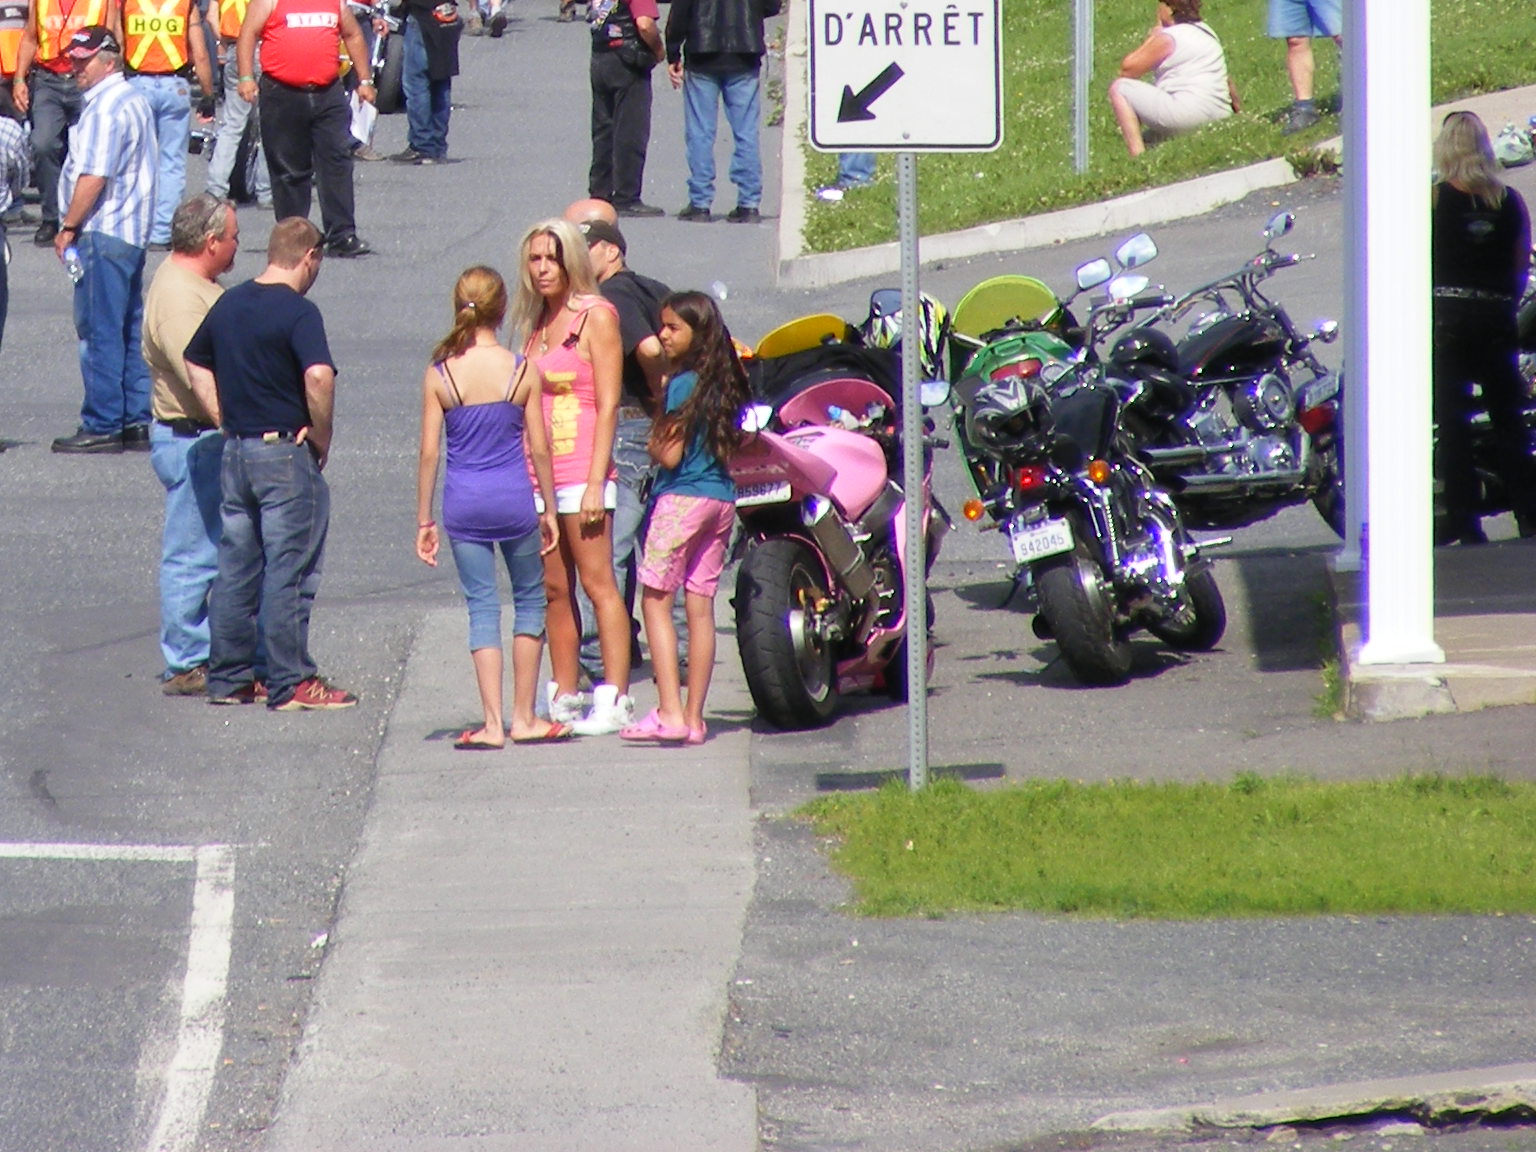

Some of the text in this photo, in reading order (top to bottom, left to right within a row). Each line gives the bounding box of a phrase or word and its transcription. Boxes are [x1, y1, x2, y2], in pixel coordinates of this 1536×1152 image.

[134, 17, 178, 33] HOG
[824, 4, 985, 46] D'ARRÊT
[1020, 534, 1065, 557] 942045
